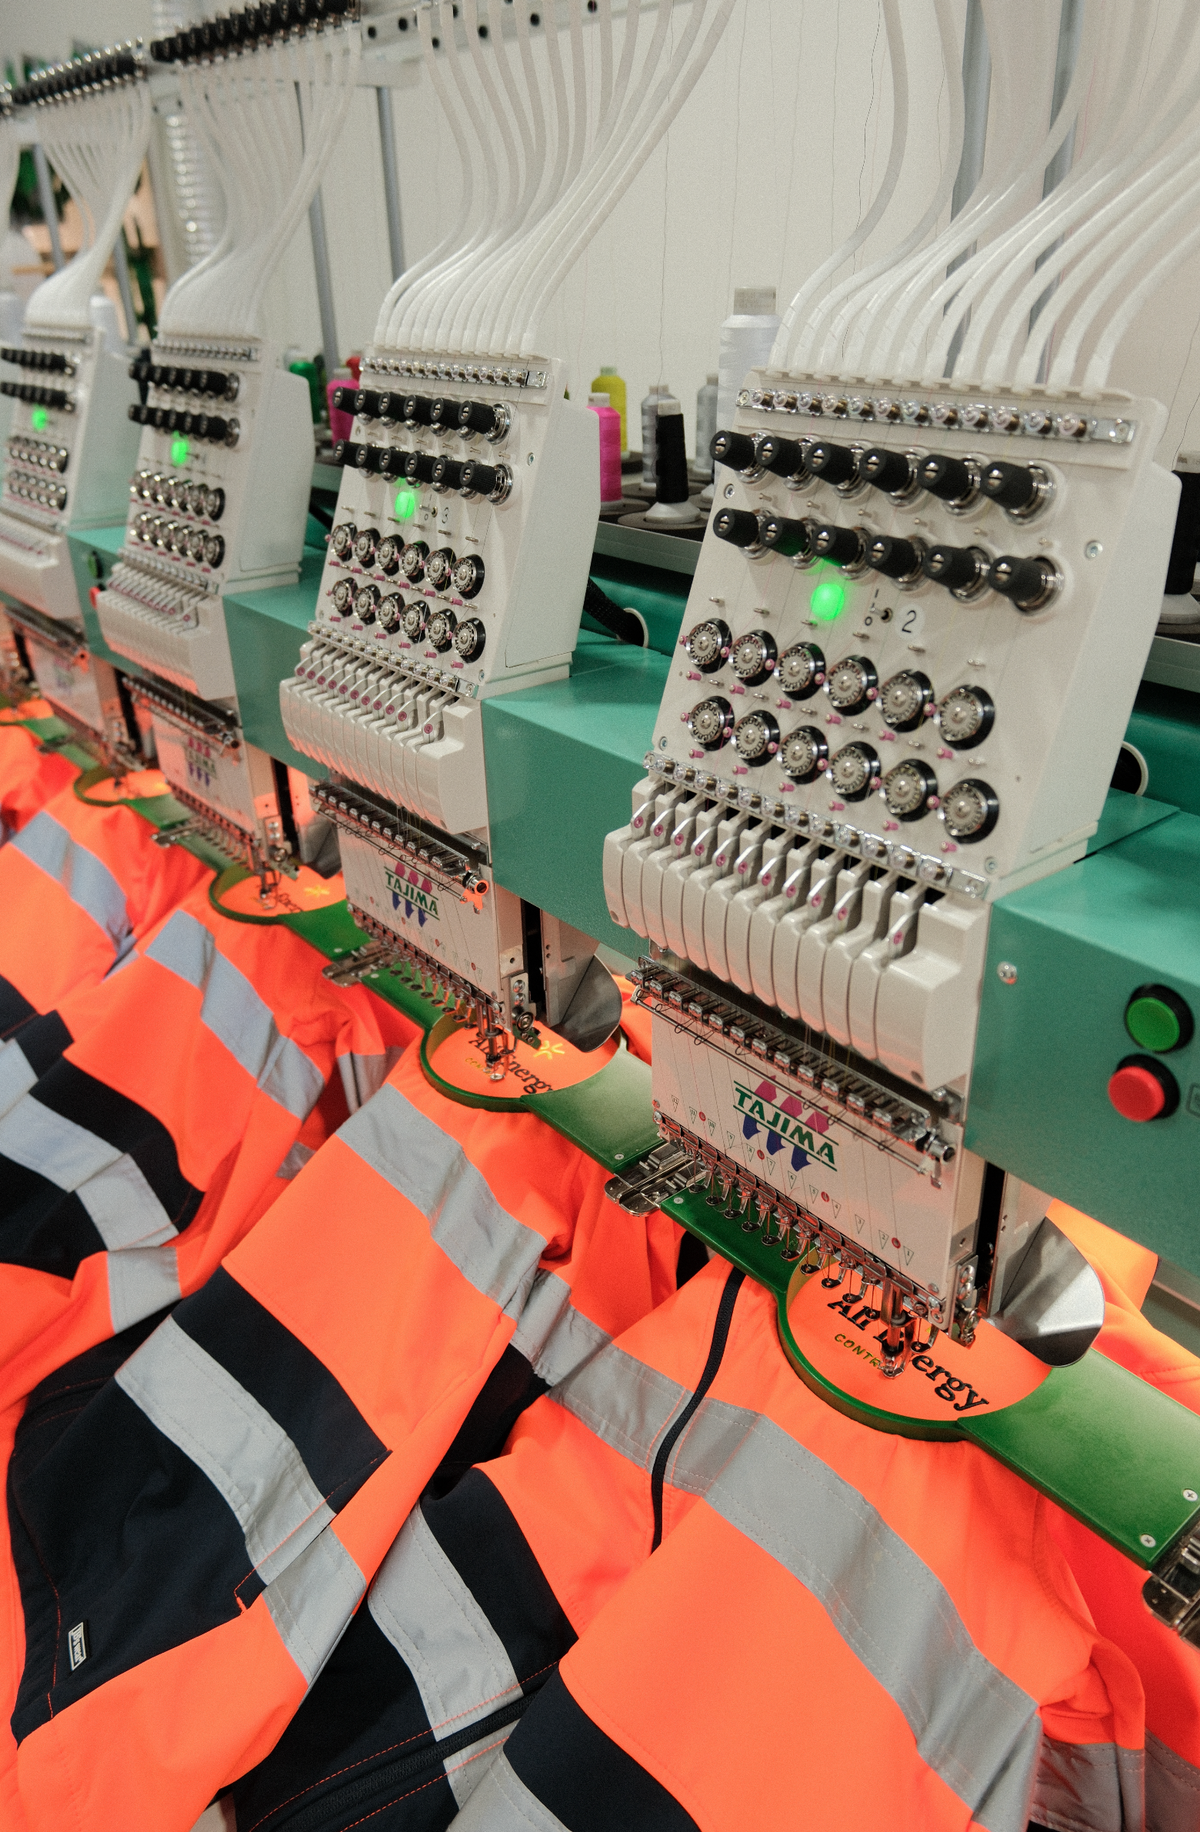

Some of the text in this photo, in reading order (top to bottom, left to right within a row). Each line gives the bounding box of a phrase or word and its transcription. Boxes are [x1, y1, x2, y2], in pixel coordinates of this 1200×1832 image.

[441, 506, 449, 524] 3
[901, 609, 917, 633] 2
[385, 870, 439, 917] TAJIMA
[734, 1087, 836, 1165] TAJIMA
